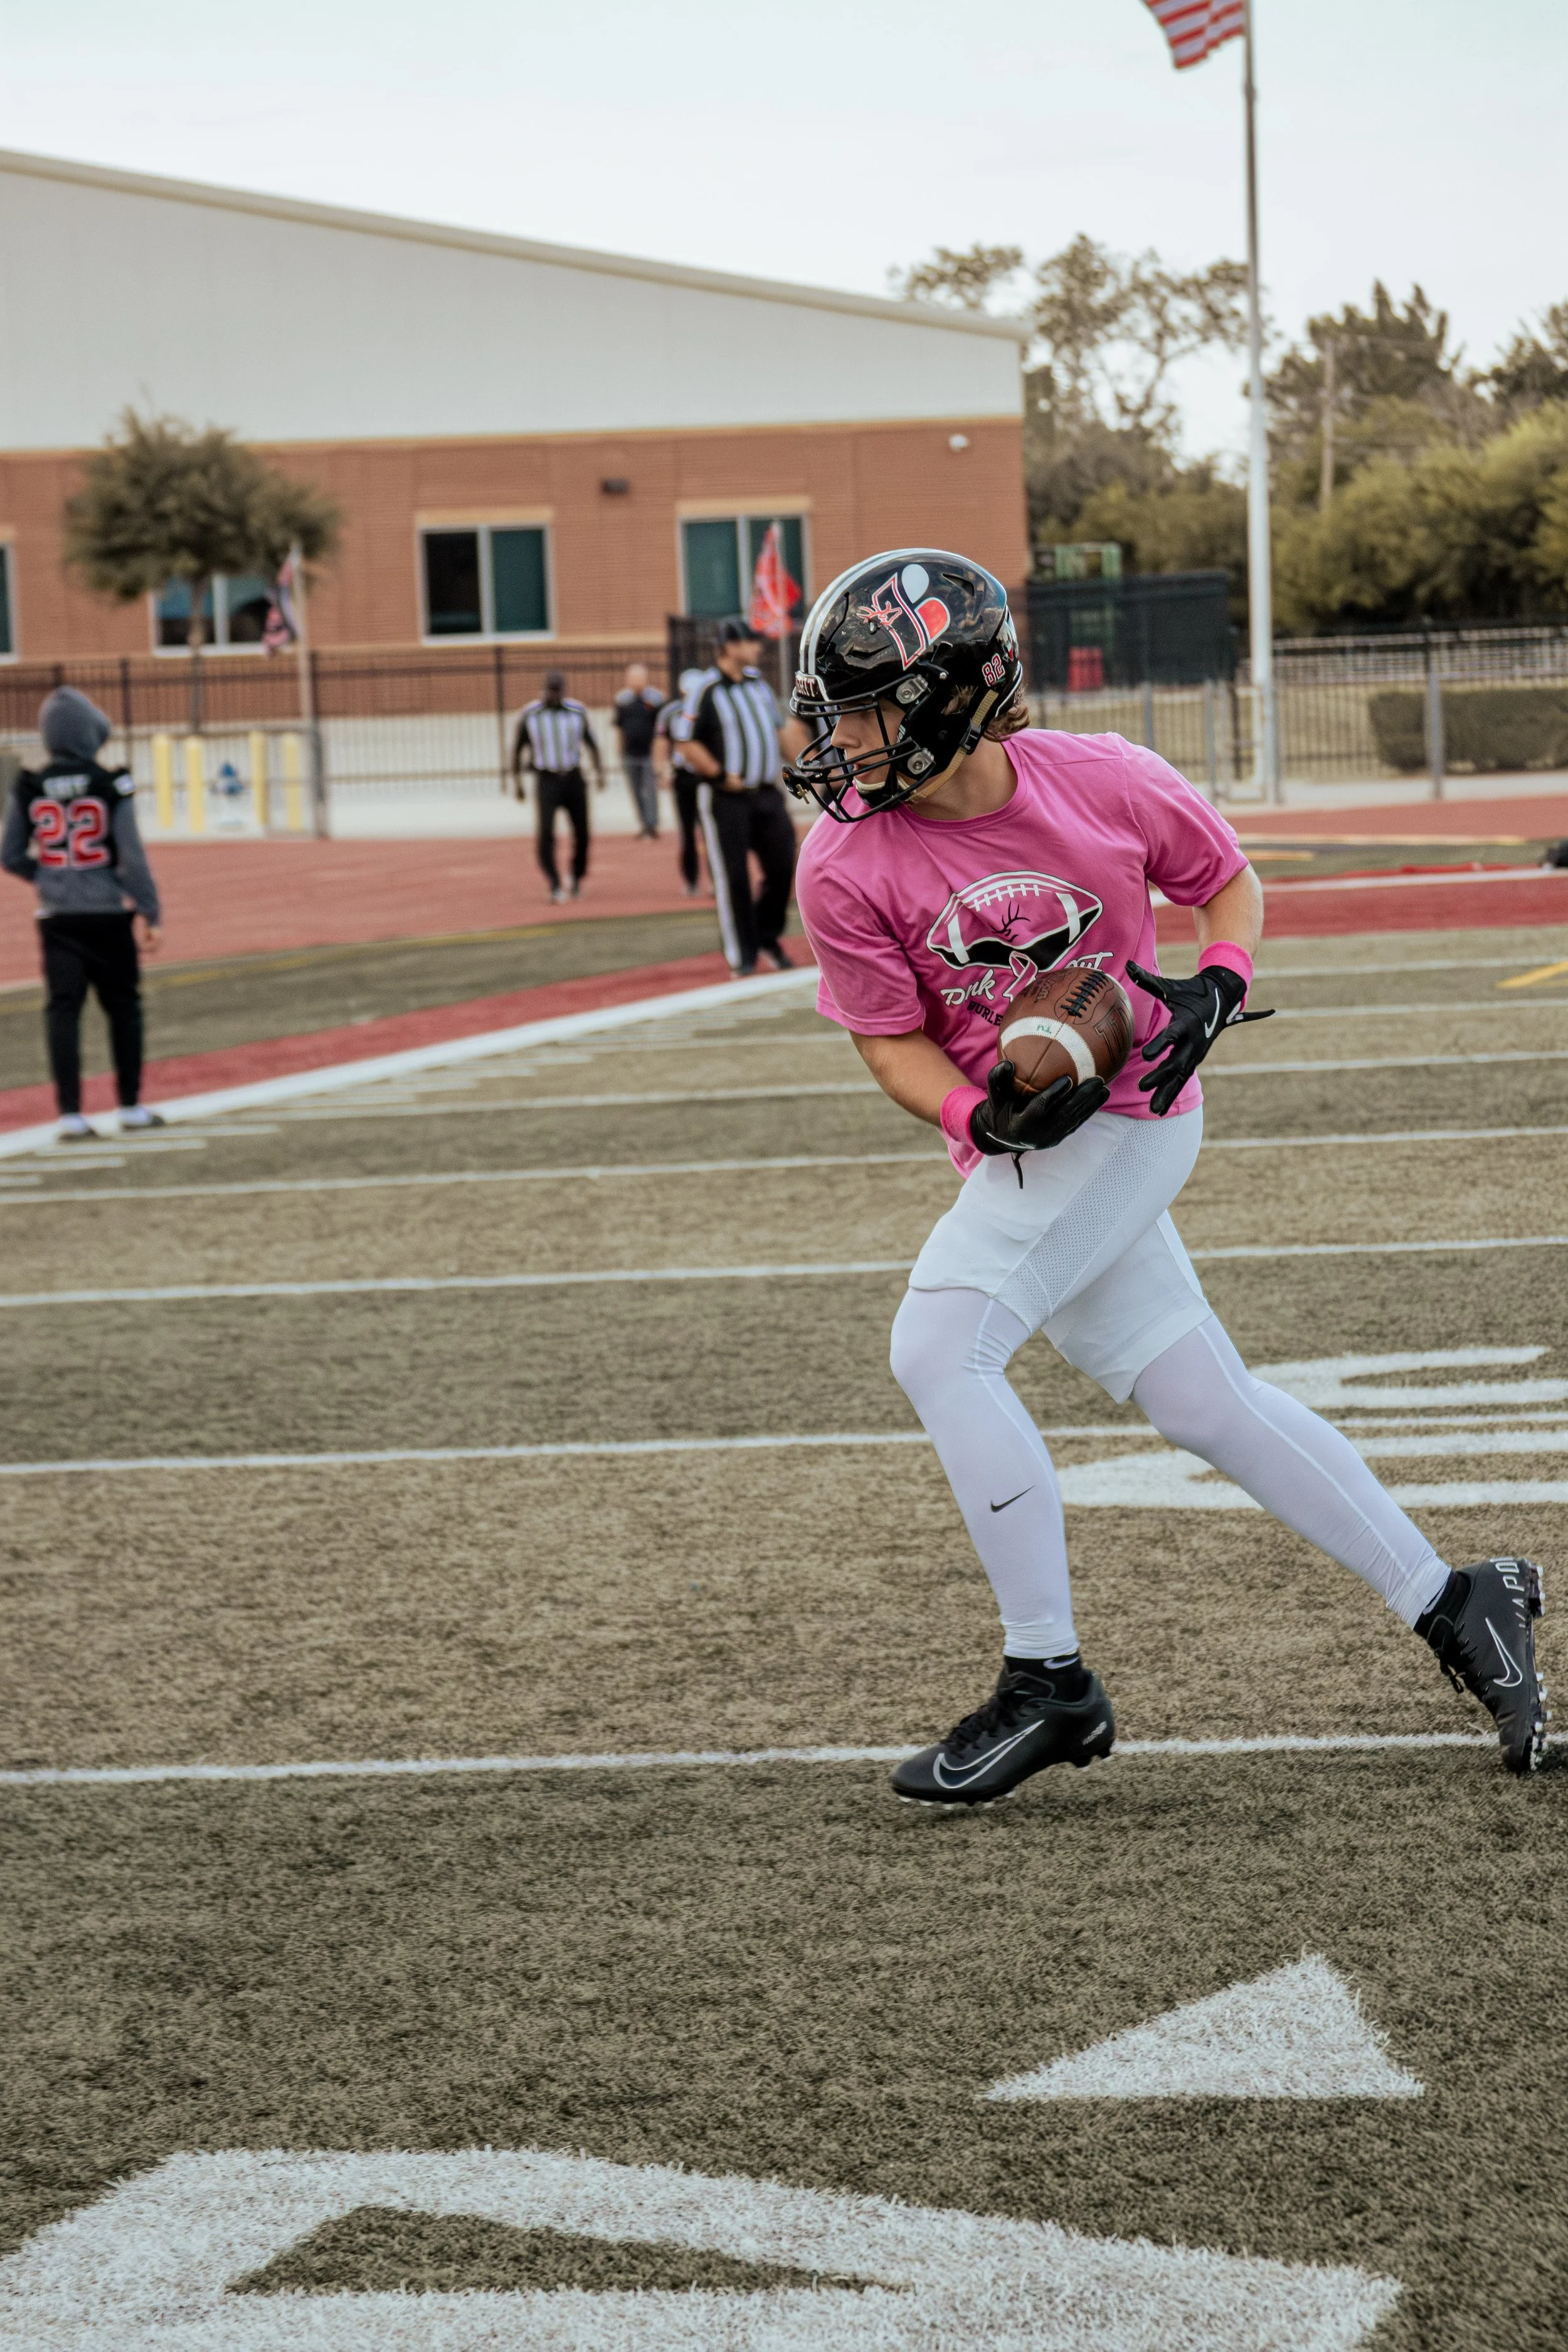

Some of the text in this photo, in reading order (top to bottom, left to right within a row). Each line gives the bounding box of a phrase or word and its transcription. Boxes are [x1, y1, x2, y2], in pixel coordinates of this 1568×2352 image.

[982, 653, 1005, 686] 82
[29, 798, 110, 869] 22
[967, 1000, 1004, 1026] BURLE
